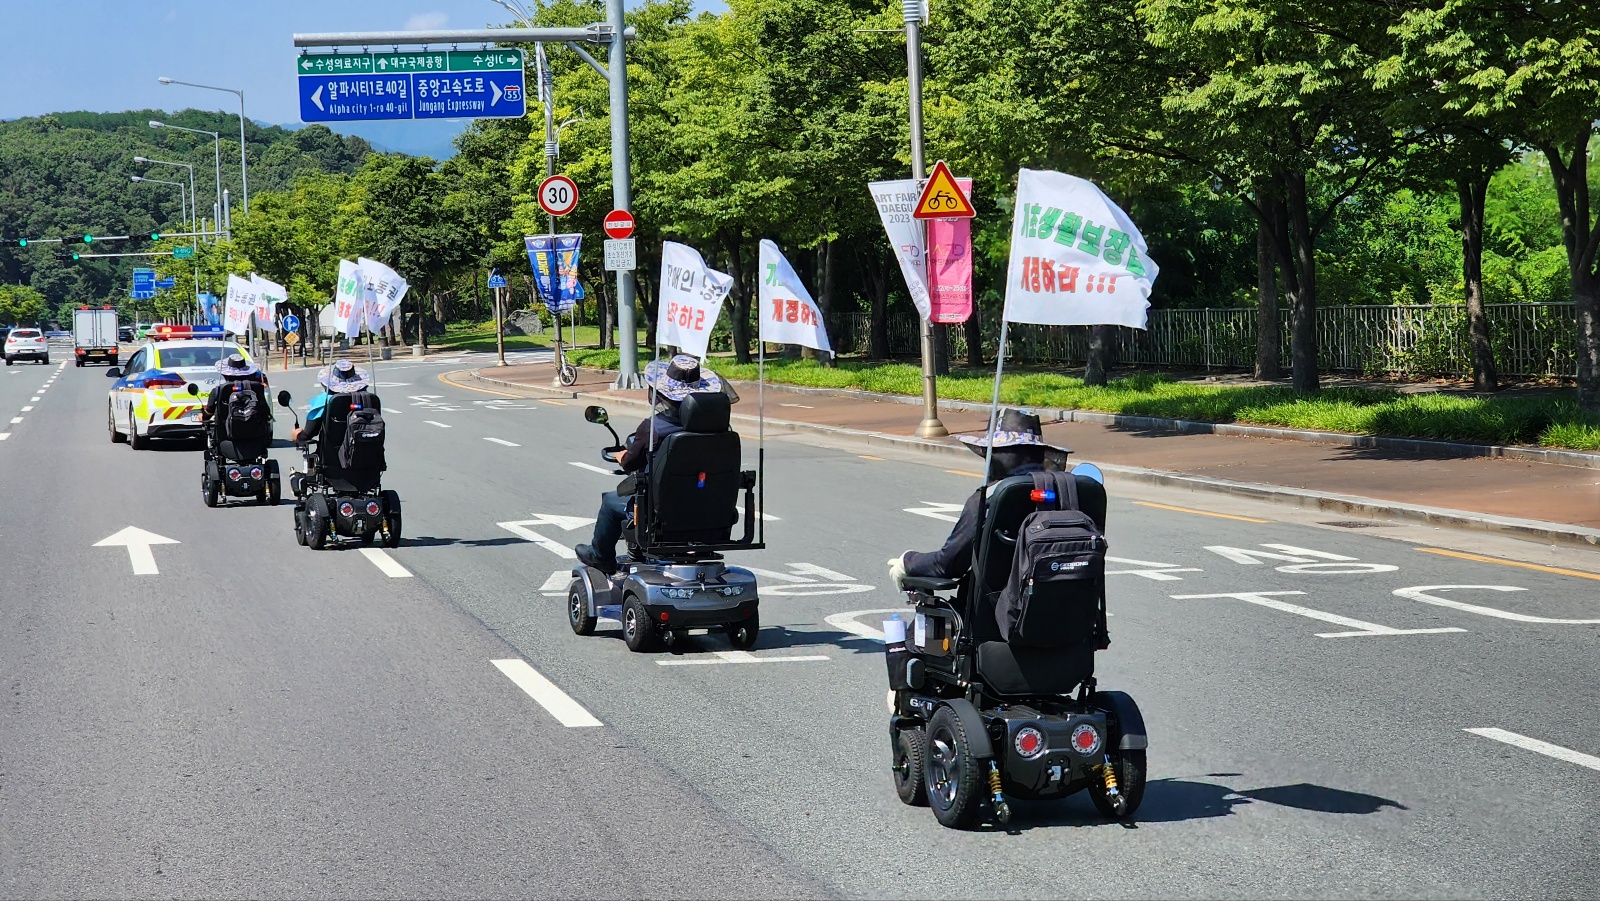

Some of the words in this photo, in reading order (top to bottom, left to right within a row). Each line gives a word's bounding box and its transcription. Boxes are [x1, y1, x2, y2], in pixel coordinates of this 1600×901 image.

[315, 58, 371, 71] 수성의료지구
[390, 56, 442, 69] 대구국제공항
[472, 54, 504, 67] 수성IC
[418, 78, 485, 97] 중앙고속도로
[507, 90, 518, 99] 55
[418, 100, 445, 114] Jungang
[447, 99, 485, 112] Expressway
[548, 187, 568, 204] 30
[874, 193, 893, 203] ART
[895, 192, 917, 202] FAIR
[881, 203, 913, 214] DAEGU
[888, 214, 911, 223] 2023
